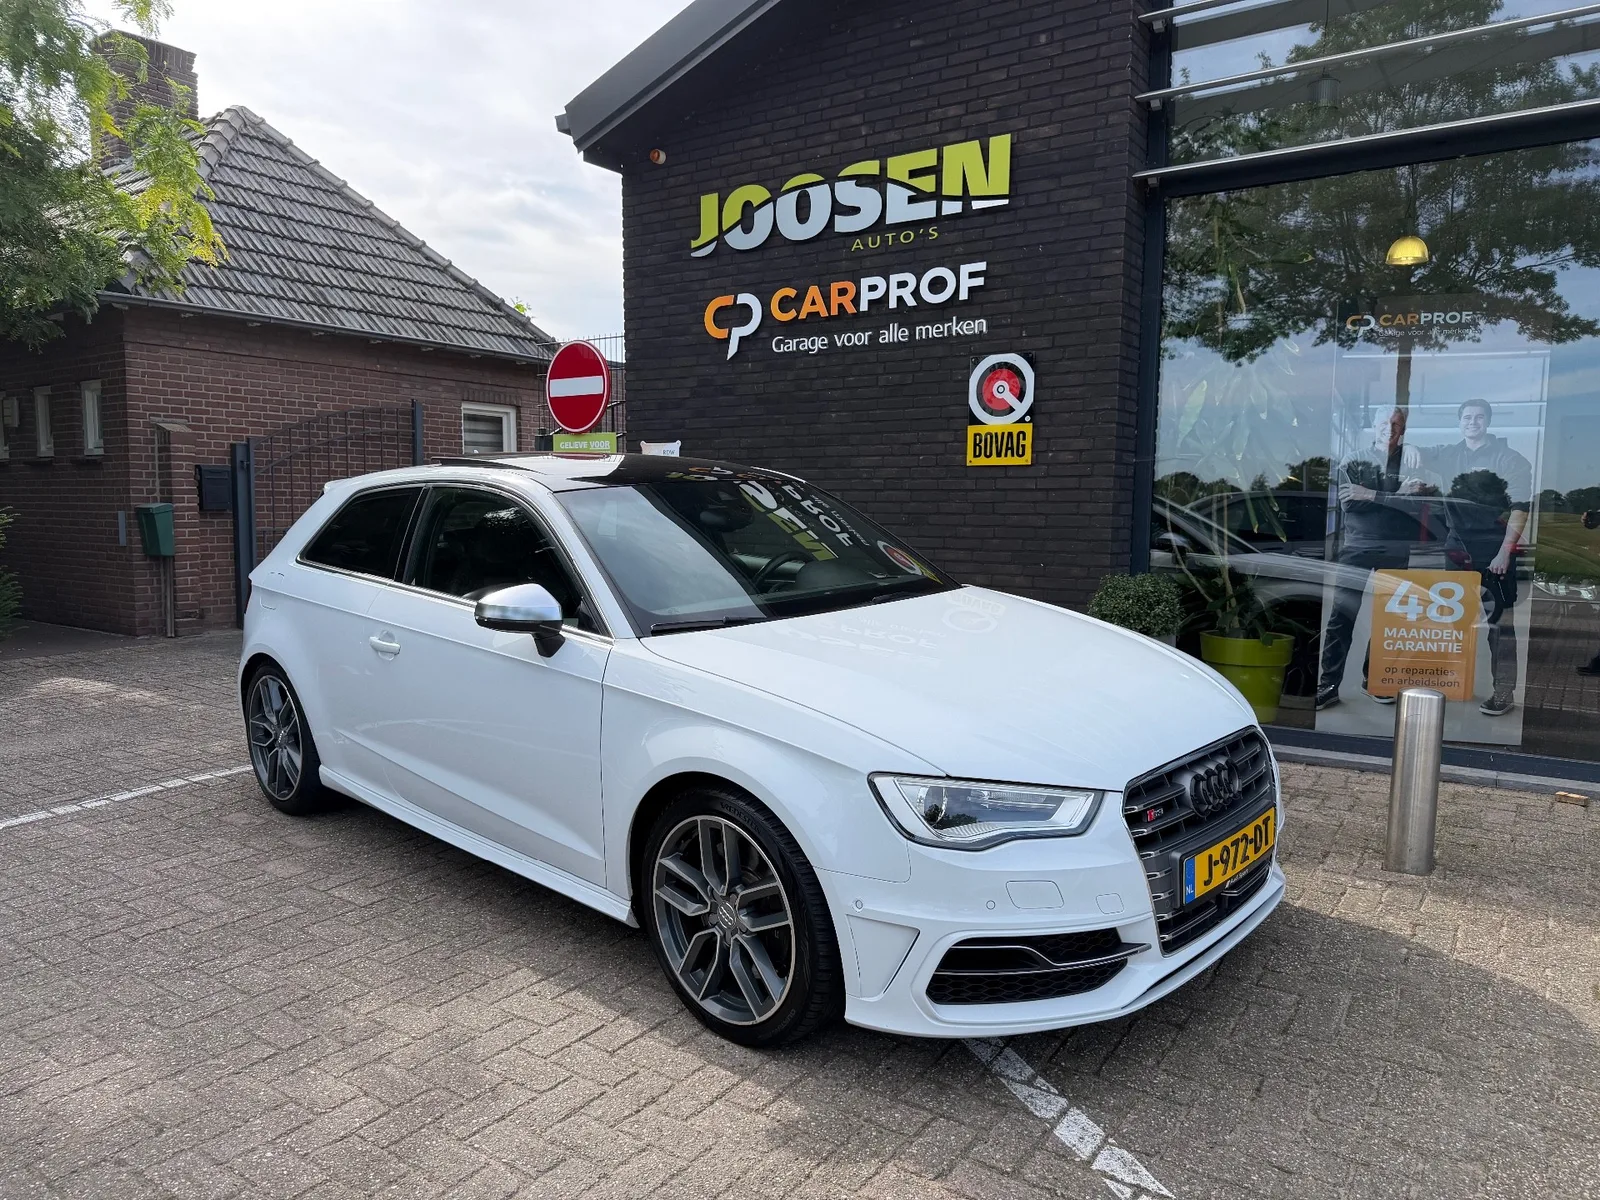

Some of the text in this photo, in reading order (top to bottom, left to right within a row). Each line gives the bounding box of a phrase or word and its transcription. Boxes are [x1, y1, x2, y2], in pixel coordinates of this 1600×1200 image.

[690, 133, 1013, 257] JOOSEN
[850, 226, 939, 252] AUTO'S
[770, 261, 988, 322] CARPROF
[1379, 311, 1474, 326] CARPROF
[771, 315, 988, 354] Garage voor alle merken
[560, 440, 610, 449] GELIEVE VOOR
[972, 430, 1027, 459] BOVAG
[1384, 581, 1465, 623] 48
[1384, 627, 1464, 641] MAANDEN
[1383, 639, 1463, 653] GARANTIE
[1384, 666, 1456, 677] op reparaties
[1381, 676, 1460, 689] en arbeidsloon
[1203, 815, 1272, 888] J-972-DT
[1186, 884, 1195, 895] NL
